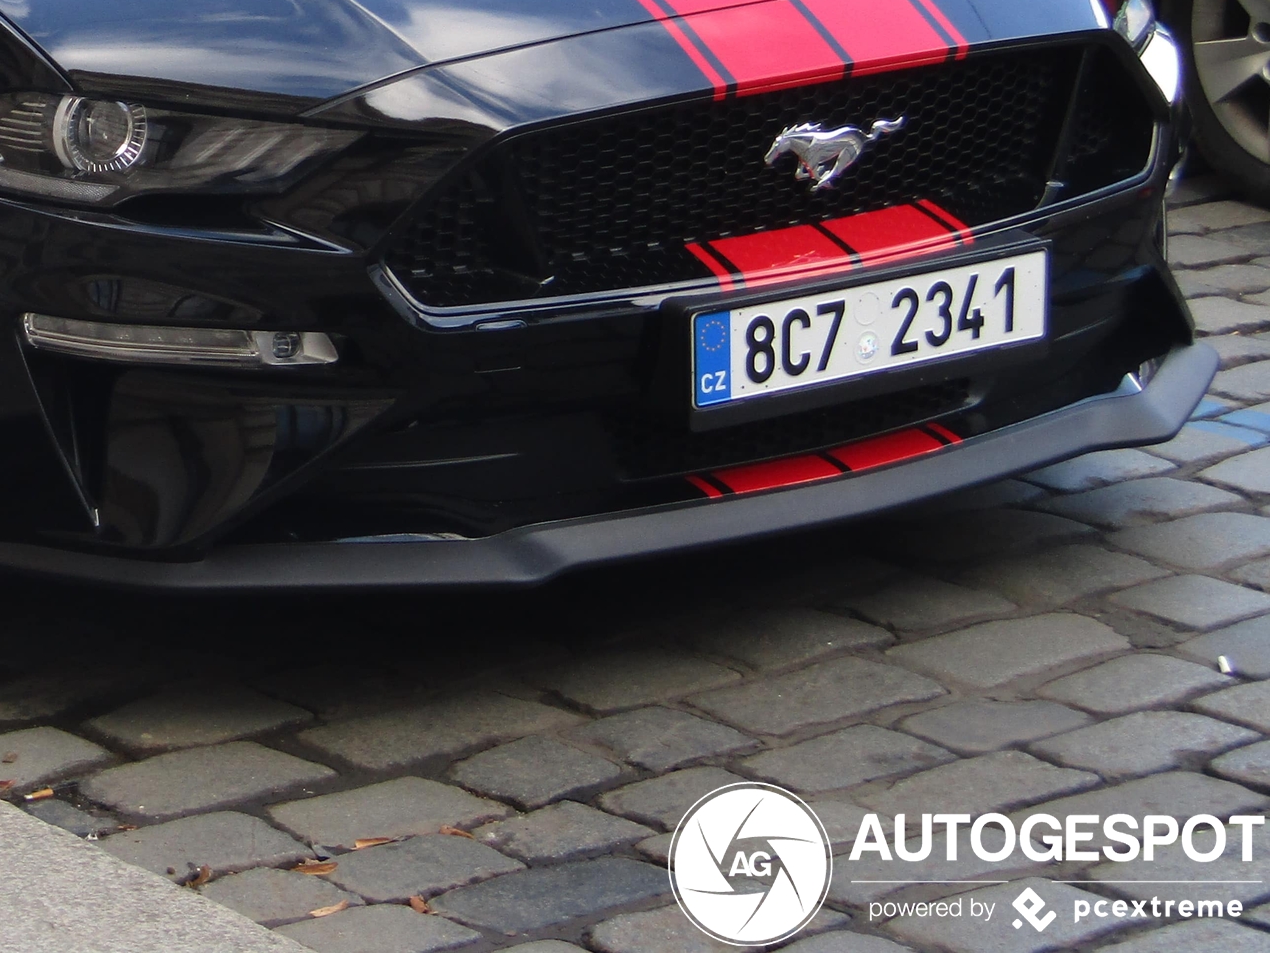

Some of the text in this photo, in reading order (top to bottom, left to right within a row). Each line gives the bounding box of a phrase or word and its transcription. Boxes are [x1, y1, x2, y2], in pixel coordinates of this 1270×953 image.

[745, 266, 1016, 383] 8C7 2341
[700, 370, 726, 394] CZ
